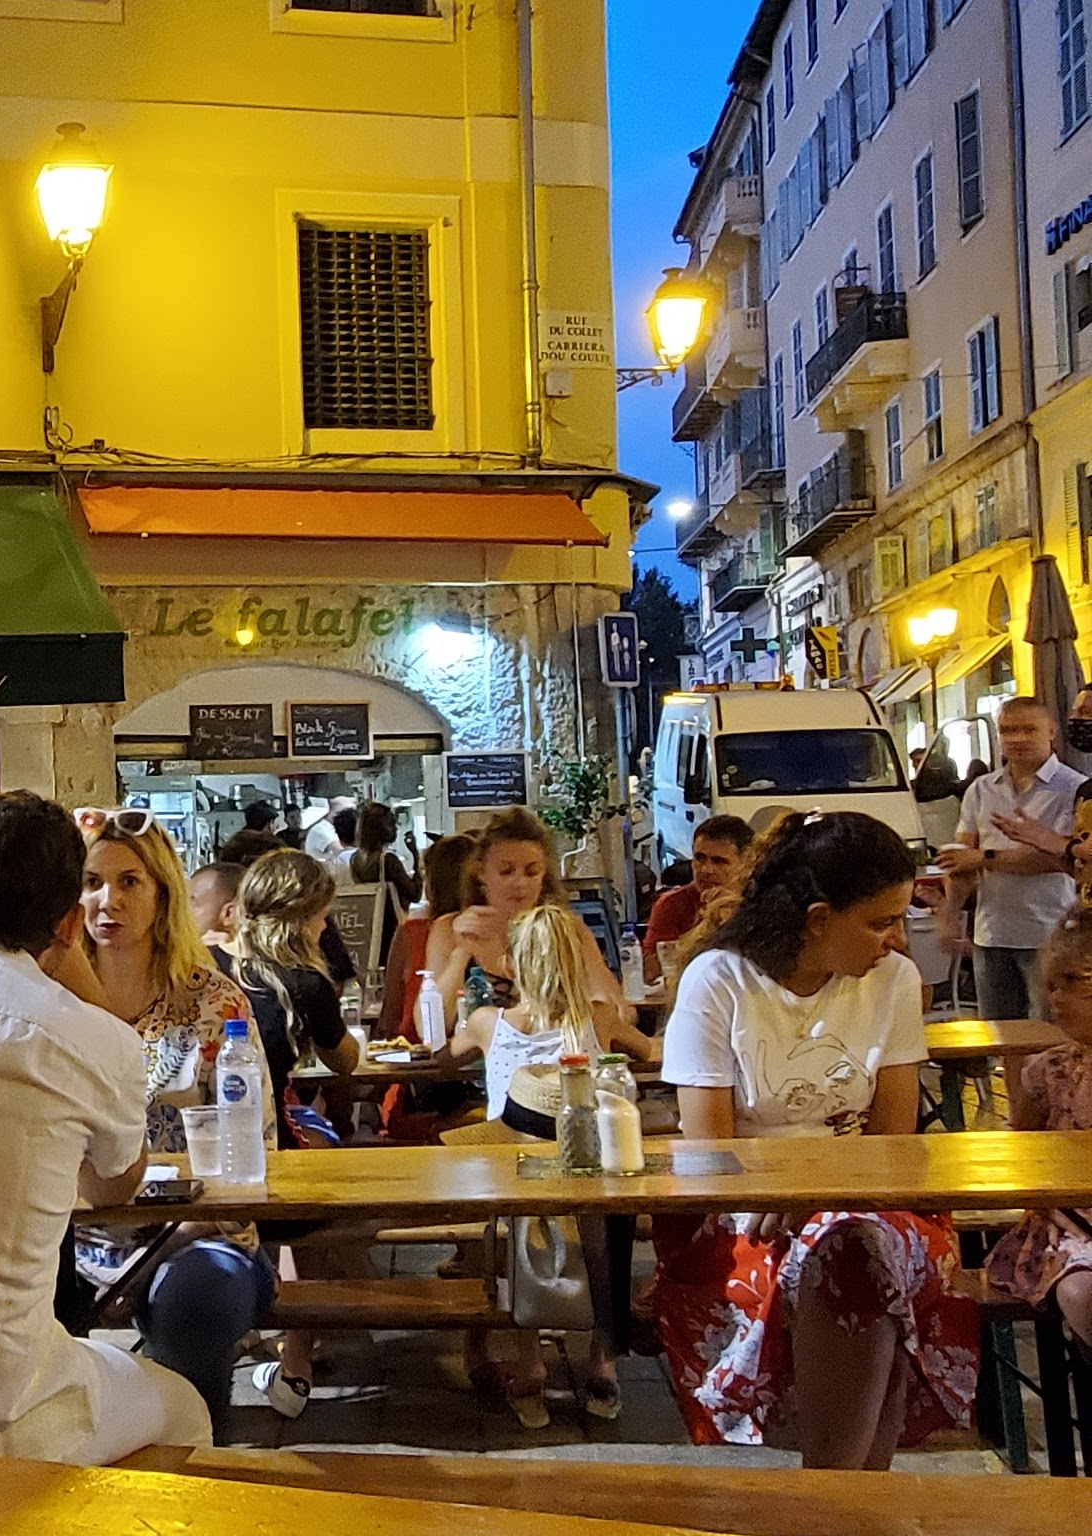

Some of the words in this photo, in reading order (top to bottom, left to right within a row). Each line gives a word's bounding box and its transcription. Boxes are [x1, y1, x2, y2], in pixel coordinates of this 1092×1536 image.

[565, 316, 587, 325] RUE
[549, 326, 564, 335] DU
[541, 351, 565, 361] DOU
[150, 598, 214, 637] Le
[236, 595, 415, 648] falafel
